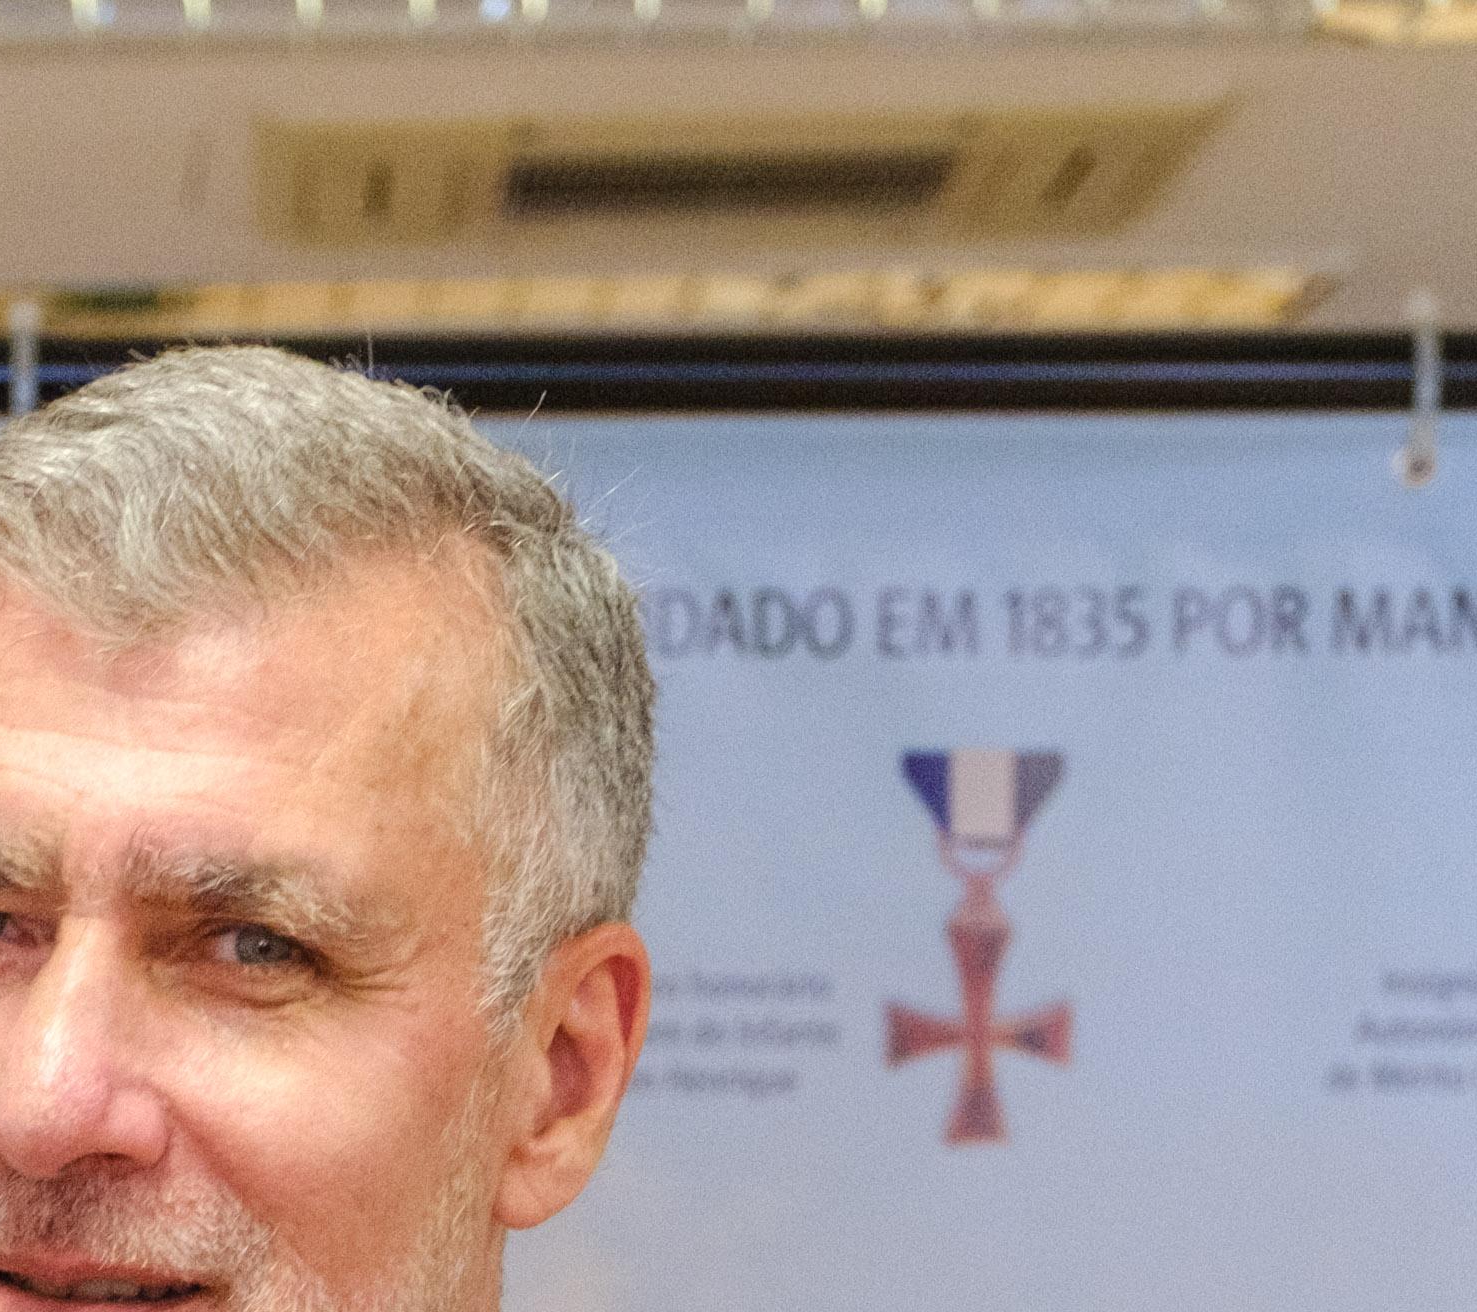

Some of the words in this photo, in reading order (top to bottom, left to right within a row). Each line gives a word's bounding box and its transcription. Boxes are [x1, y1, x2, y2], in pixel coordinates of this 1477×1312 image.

[873, 584, 980, 662] EM
[1000, 581, 1153, 660] 1835
[1170, 580, 1313, 660] POR
